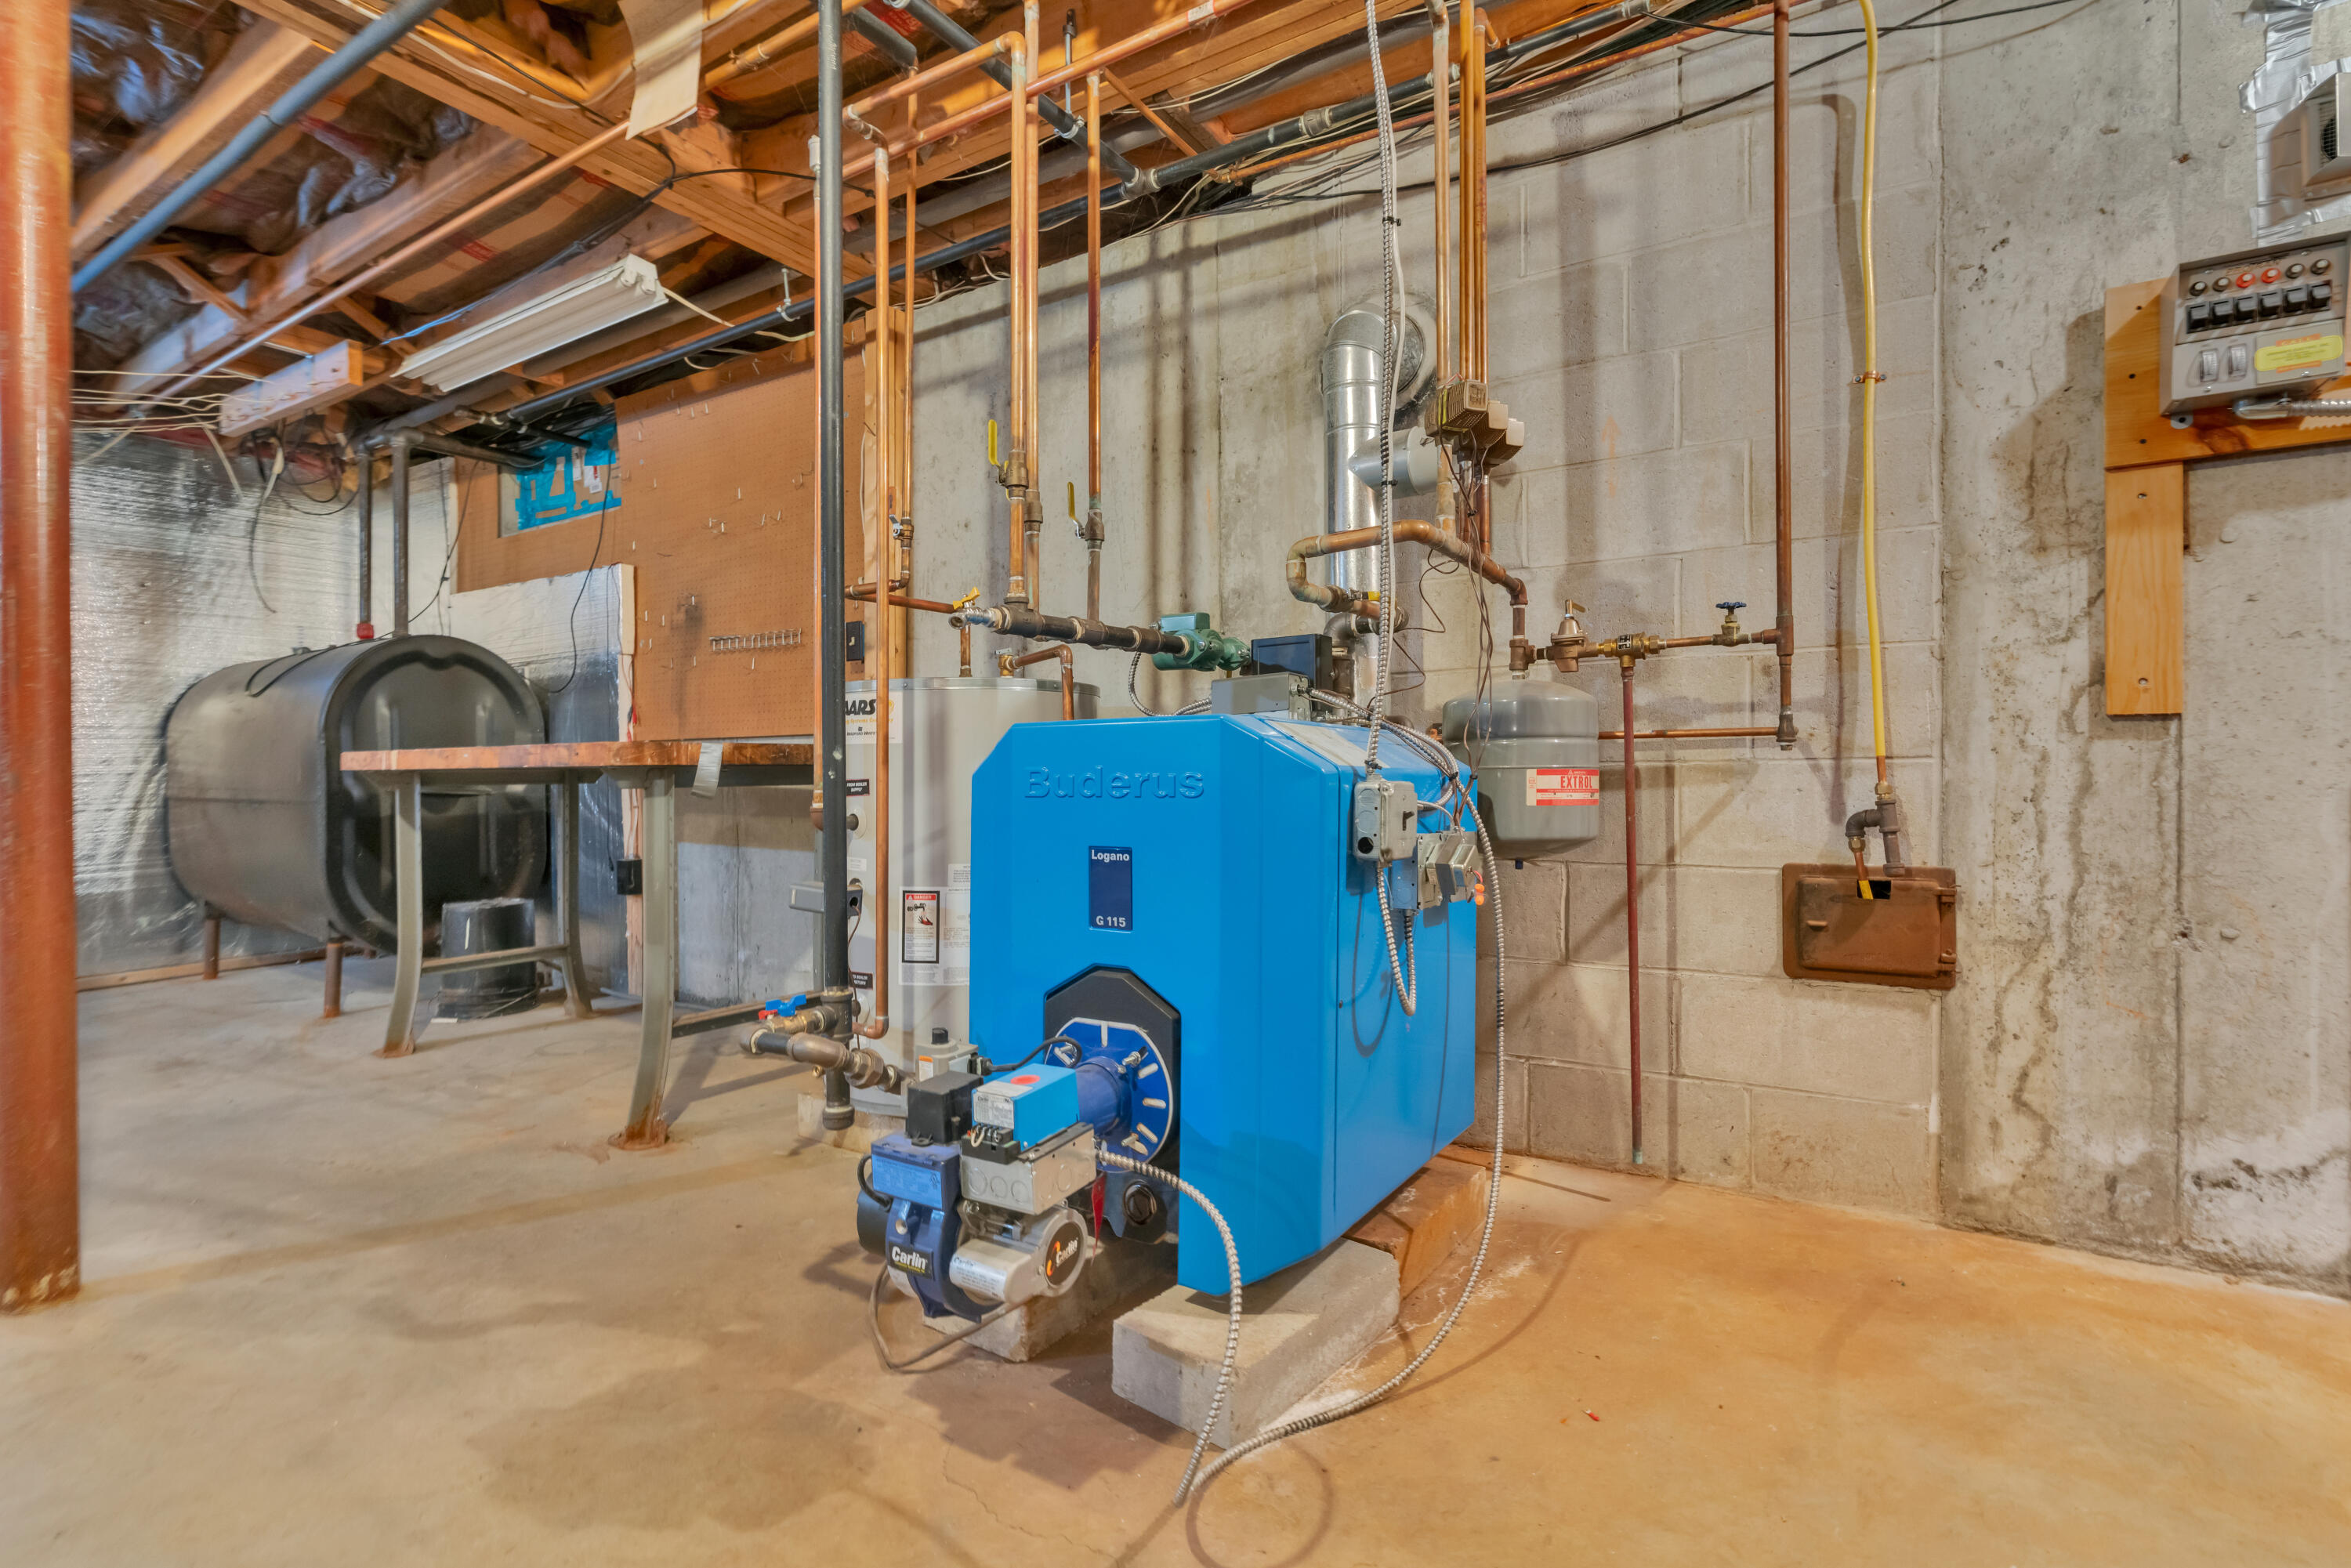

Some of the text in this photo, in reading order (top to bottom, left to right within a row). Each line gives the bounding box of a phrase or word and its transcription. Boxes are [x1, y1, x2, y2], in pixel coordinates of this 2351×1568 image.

[1023, 766, 1205, 798] Buderus
[1560, 776, 1592, 788] EXTROL
[1091, 849, 1130, 863] Logano
[1096, 915, 1126, 928] G 115
[892, 1245, 926, 1270] Carlin
[1056, 1239, 1078, 1266] Carlin
